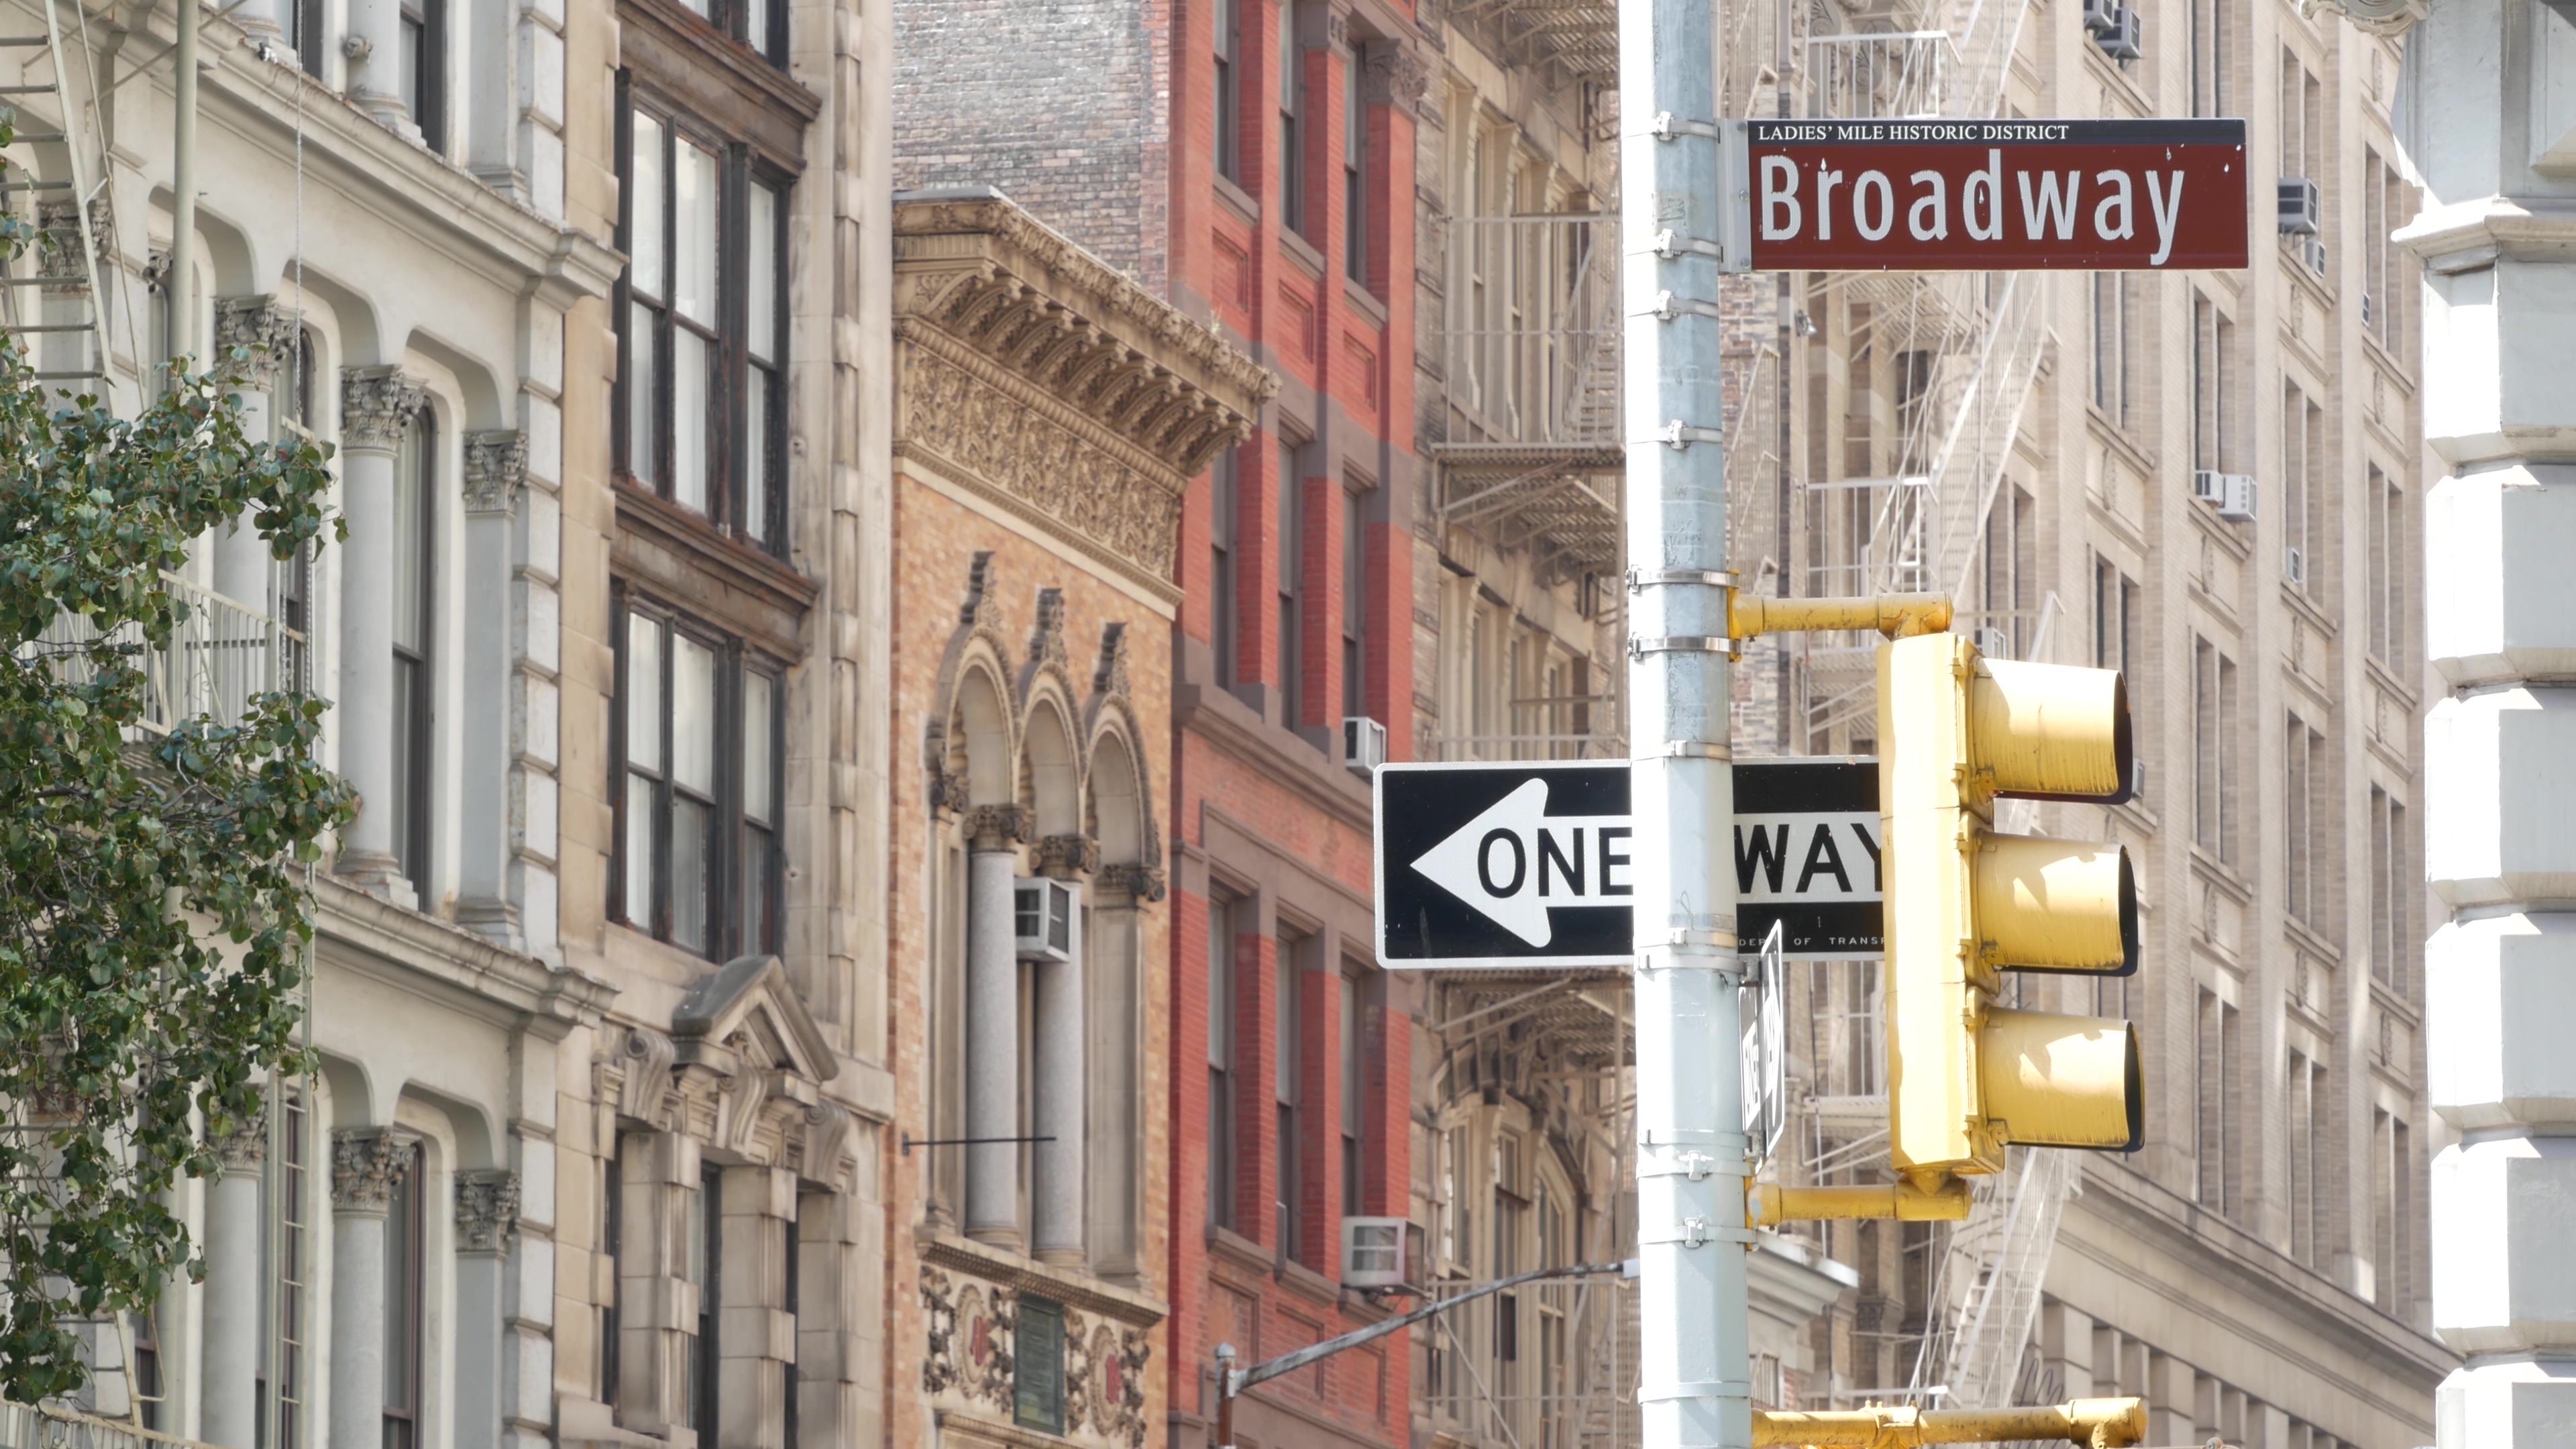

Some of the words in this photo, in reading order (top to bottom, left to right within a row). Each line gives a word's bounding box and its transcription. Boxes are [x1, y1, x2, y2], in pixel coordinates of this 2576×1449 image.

[1758, 125, 1833, 140] LADIES’
[1837, 125, 1884, 140] MILE
[1889, 125, 1978, 140] HISTORIC
[1983, 125, 2070, 140] DISTRICT
[1760, 148, 2185, 266] Broadway
[1477, 826, 1633, 899] ONE
[1733, 823, 1883, 894] WAY
[1739, 938, 1767, 947] DEP
[1794, 938, 1811, 946] OF
